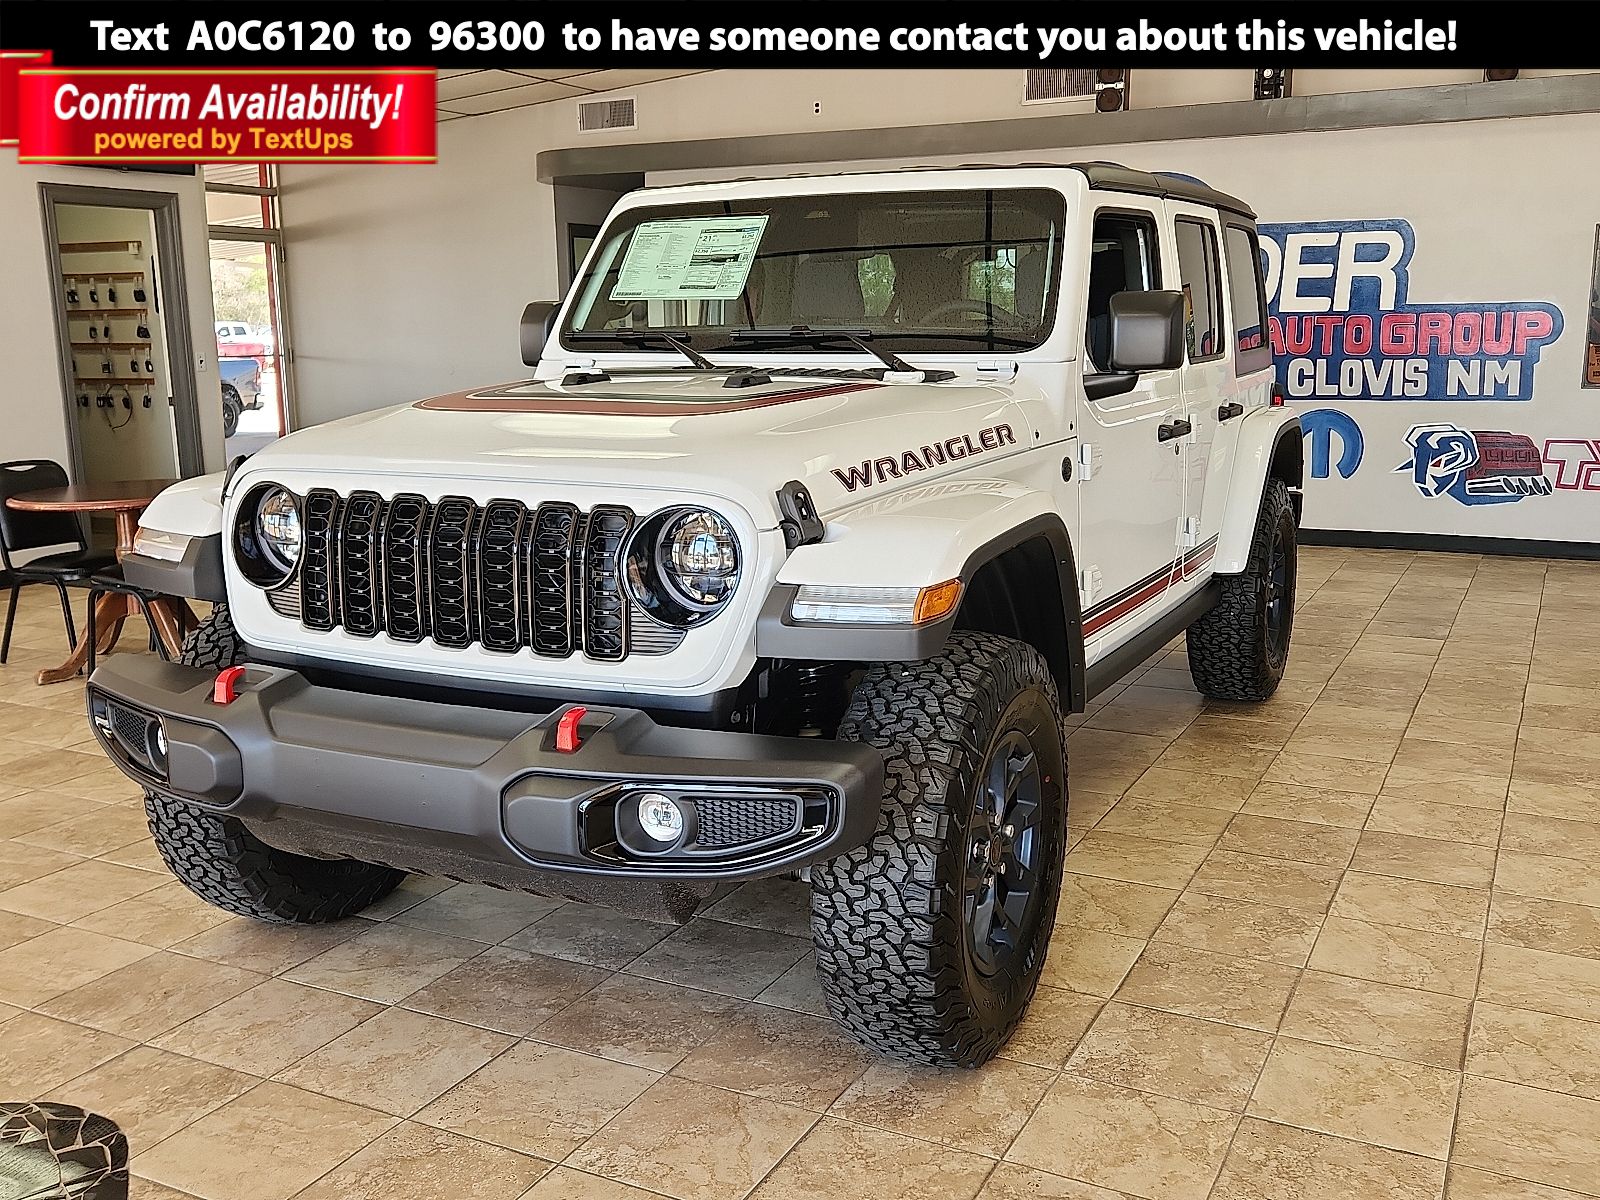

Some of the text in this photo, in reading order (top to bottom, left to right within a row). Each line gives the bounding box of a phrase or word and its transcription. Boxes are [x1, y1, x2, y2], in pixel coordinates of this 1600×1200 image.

[1268, 313, 1373, 356] AUTO
[1380, 311, 1554, 356] GROUP
[1287, 358, 1522, 397] CLOVIS NM
[829, 423, 1017, 493] WRANGLER
